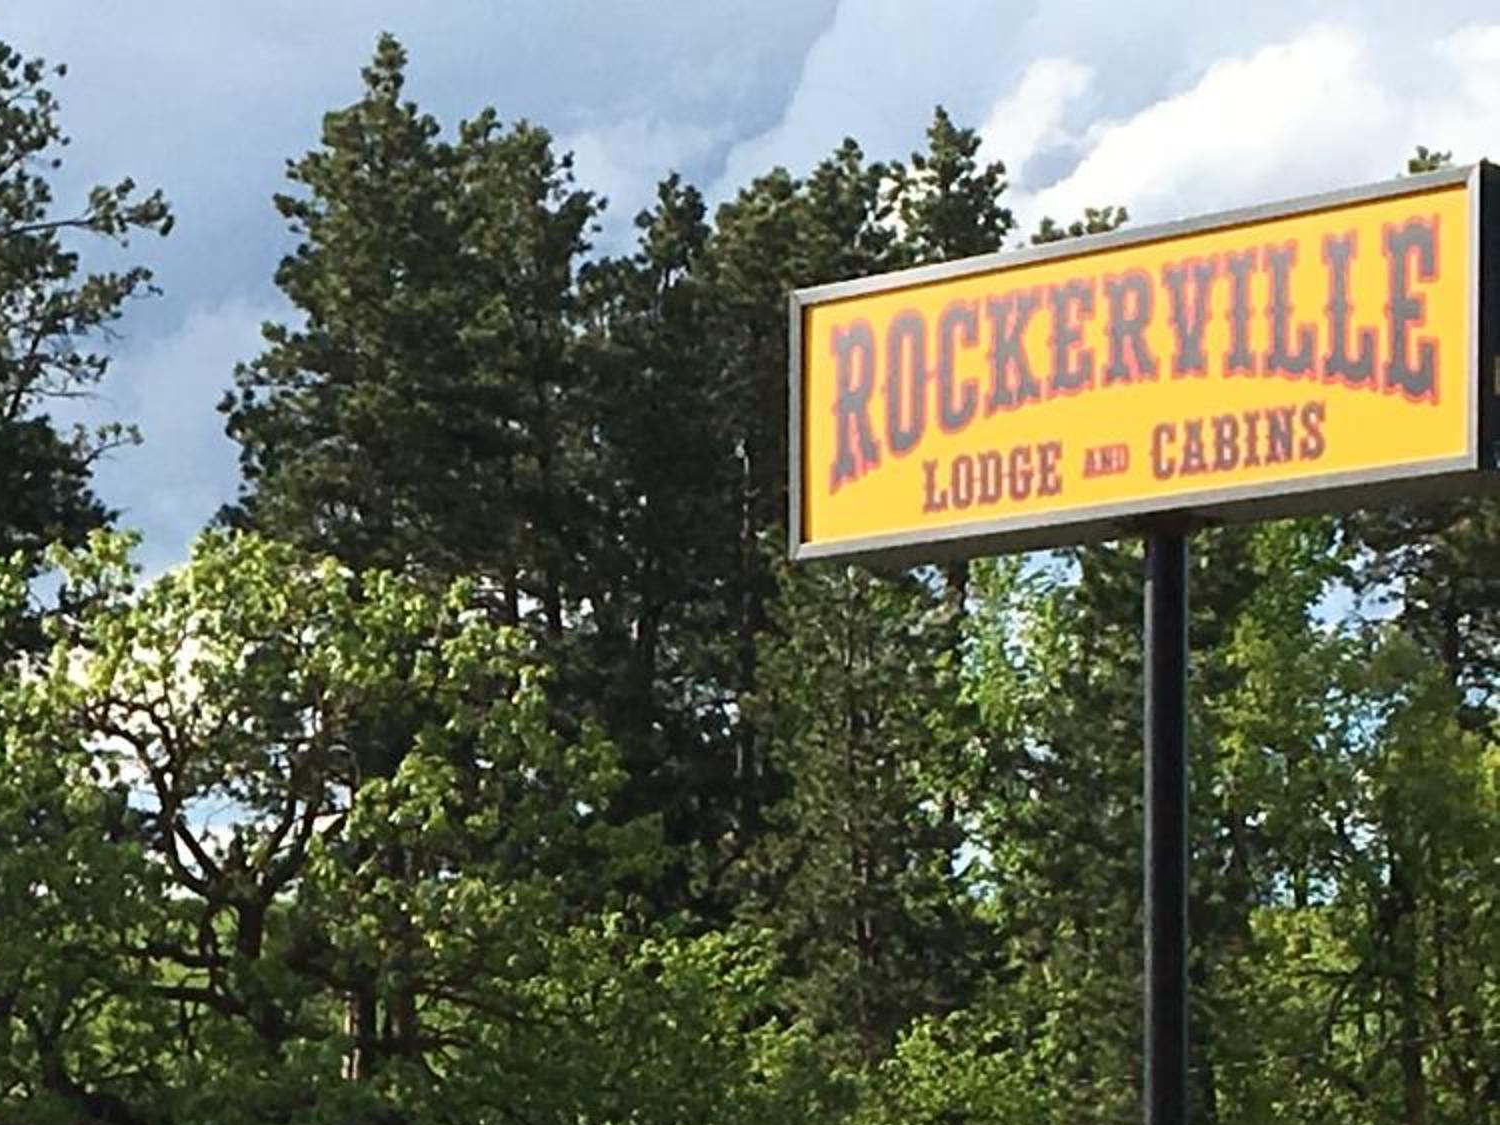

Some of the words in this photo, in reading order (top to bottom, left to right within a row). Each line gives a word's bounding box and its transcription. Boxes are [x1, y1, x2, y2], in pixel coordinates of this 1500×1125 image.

[830, 214, 1440, 493] ROCKERVILLE
[922, 441, 1063, 514] LODGE
[1083, 443, 1130, 480] AND
[1150, 401, 1328, 481] CABINS
